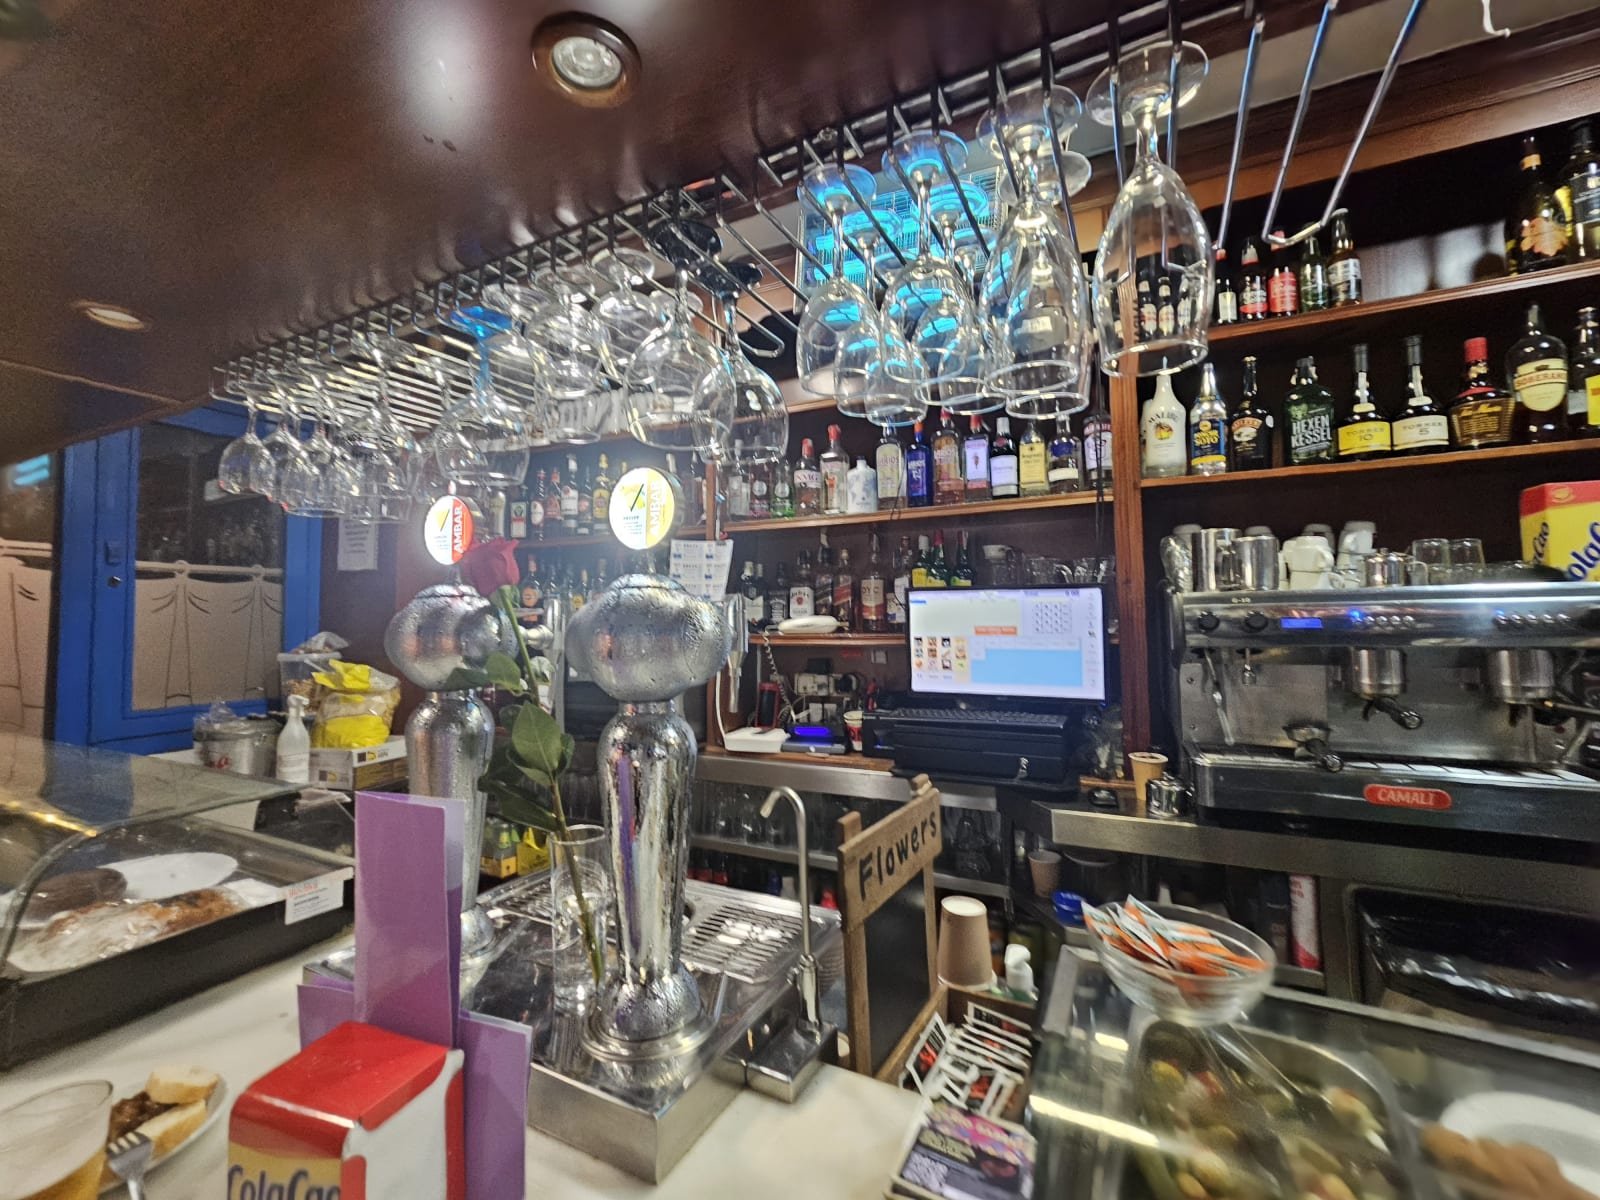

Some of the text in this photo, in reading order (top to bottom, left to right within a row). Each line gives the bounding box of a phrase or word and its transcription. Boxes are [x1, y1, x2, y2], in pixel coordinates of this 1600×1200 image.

[1292, 414, 1330, 435] HEXEN
[1346, 427, 1385, 437] TORRES
[1402, 421, 1443, 431] TORRES
[1419, 427, 1430, 436] 5
[1291, 427, 1332, 449] KESSEL
[1359, 433, 1374, 442] 10
[453, 506, 464, 554] AMBAR
[1377, 788, 1435, 806] CAMALI
[859, 811, 937, 902] Flowers
